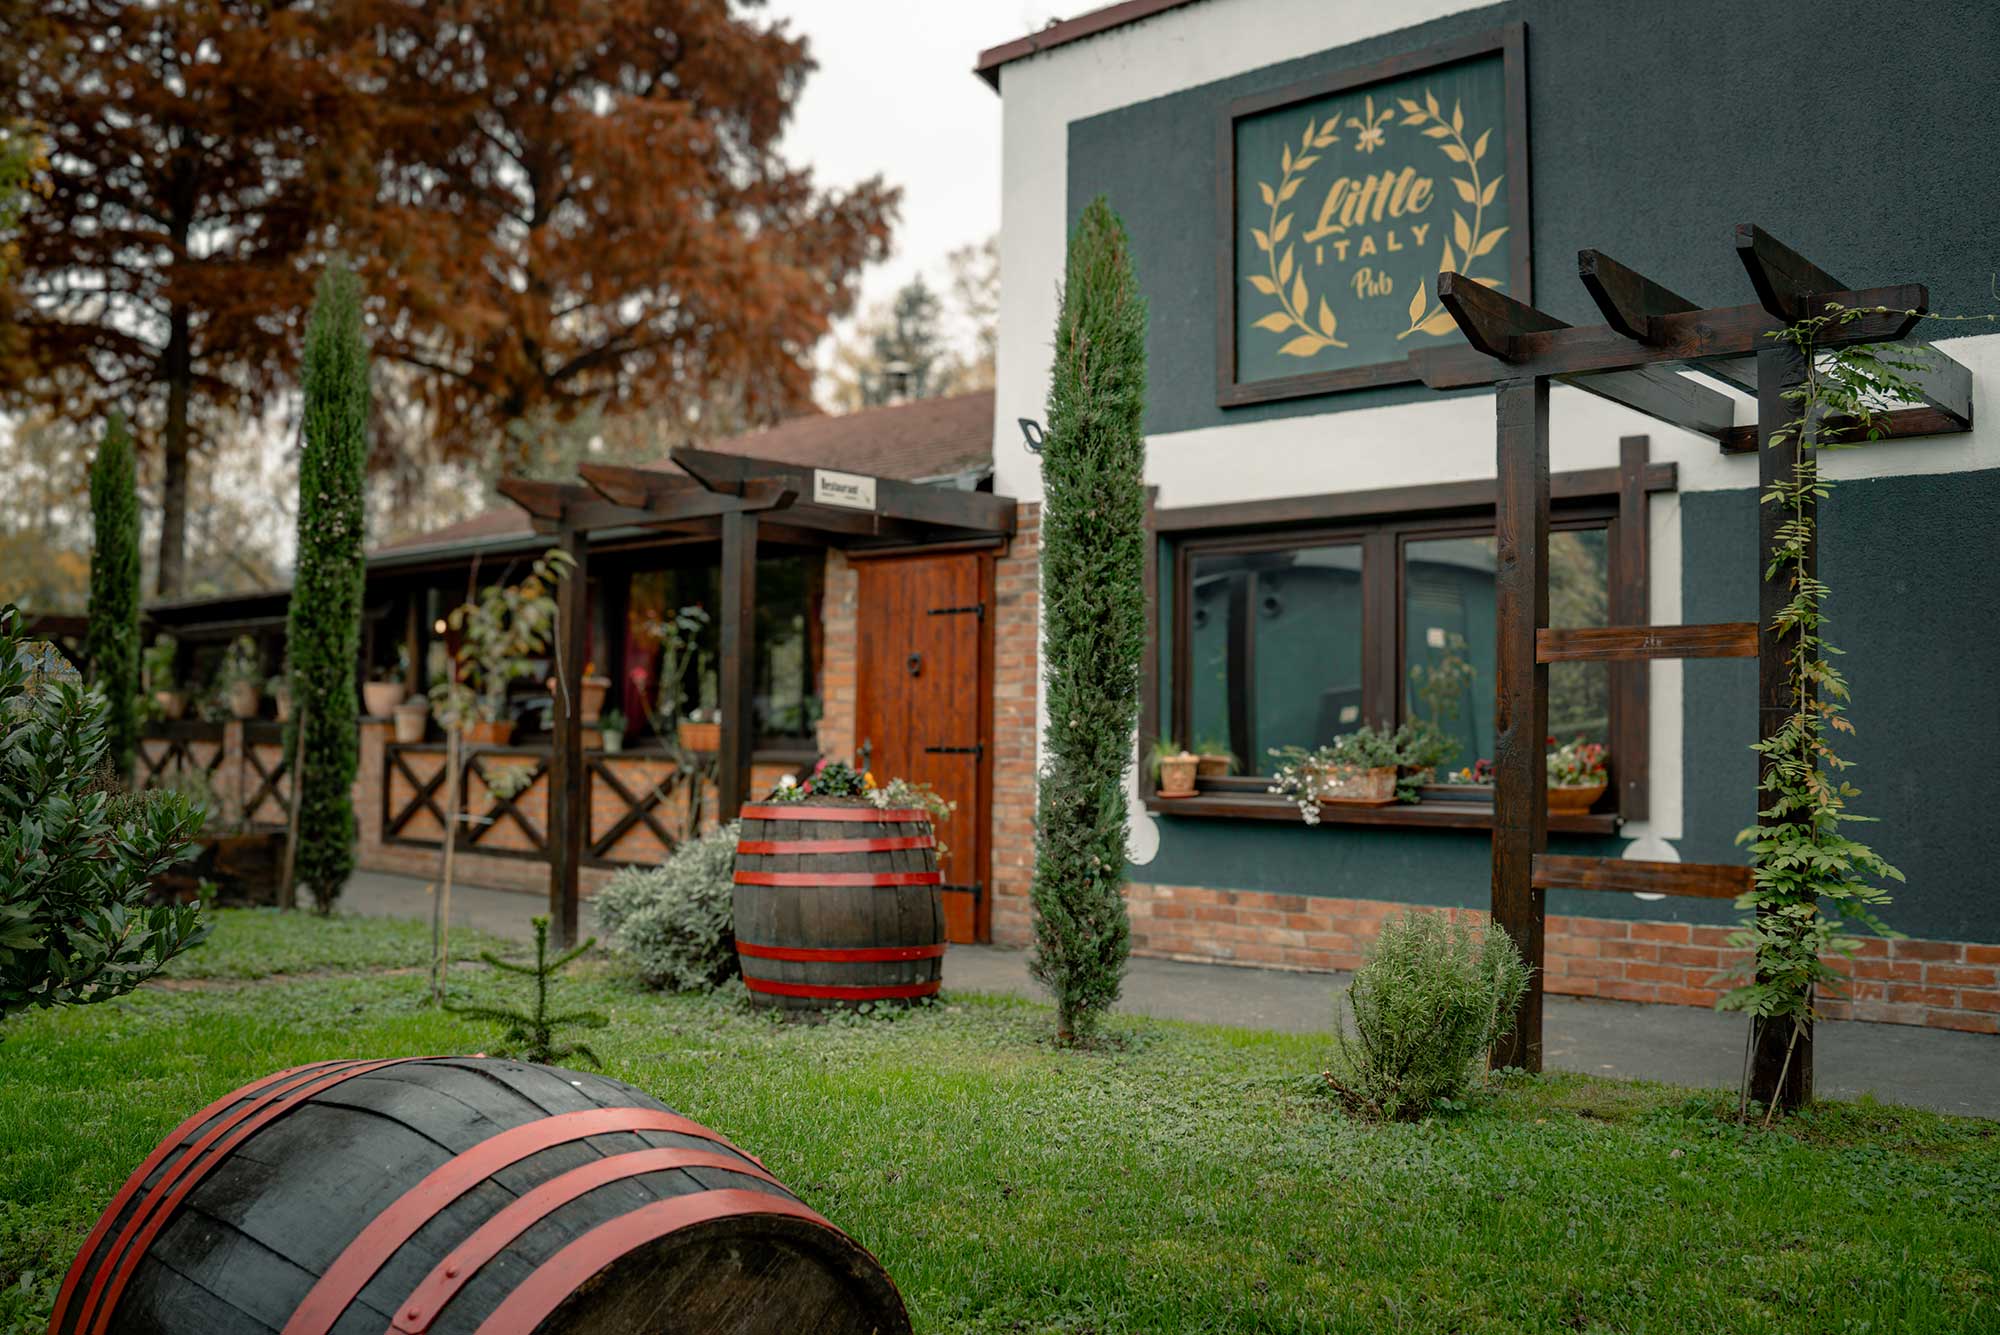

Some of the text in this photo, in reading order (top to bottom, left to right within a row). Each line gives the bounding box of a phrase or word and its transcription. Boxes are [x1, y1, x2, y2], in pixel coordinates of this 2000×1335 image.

[1303, 166, 1434, 243] Little
[1316, 223, 1430, 266] ITALY
[1352, 267, 1393, 300] Pub
